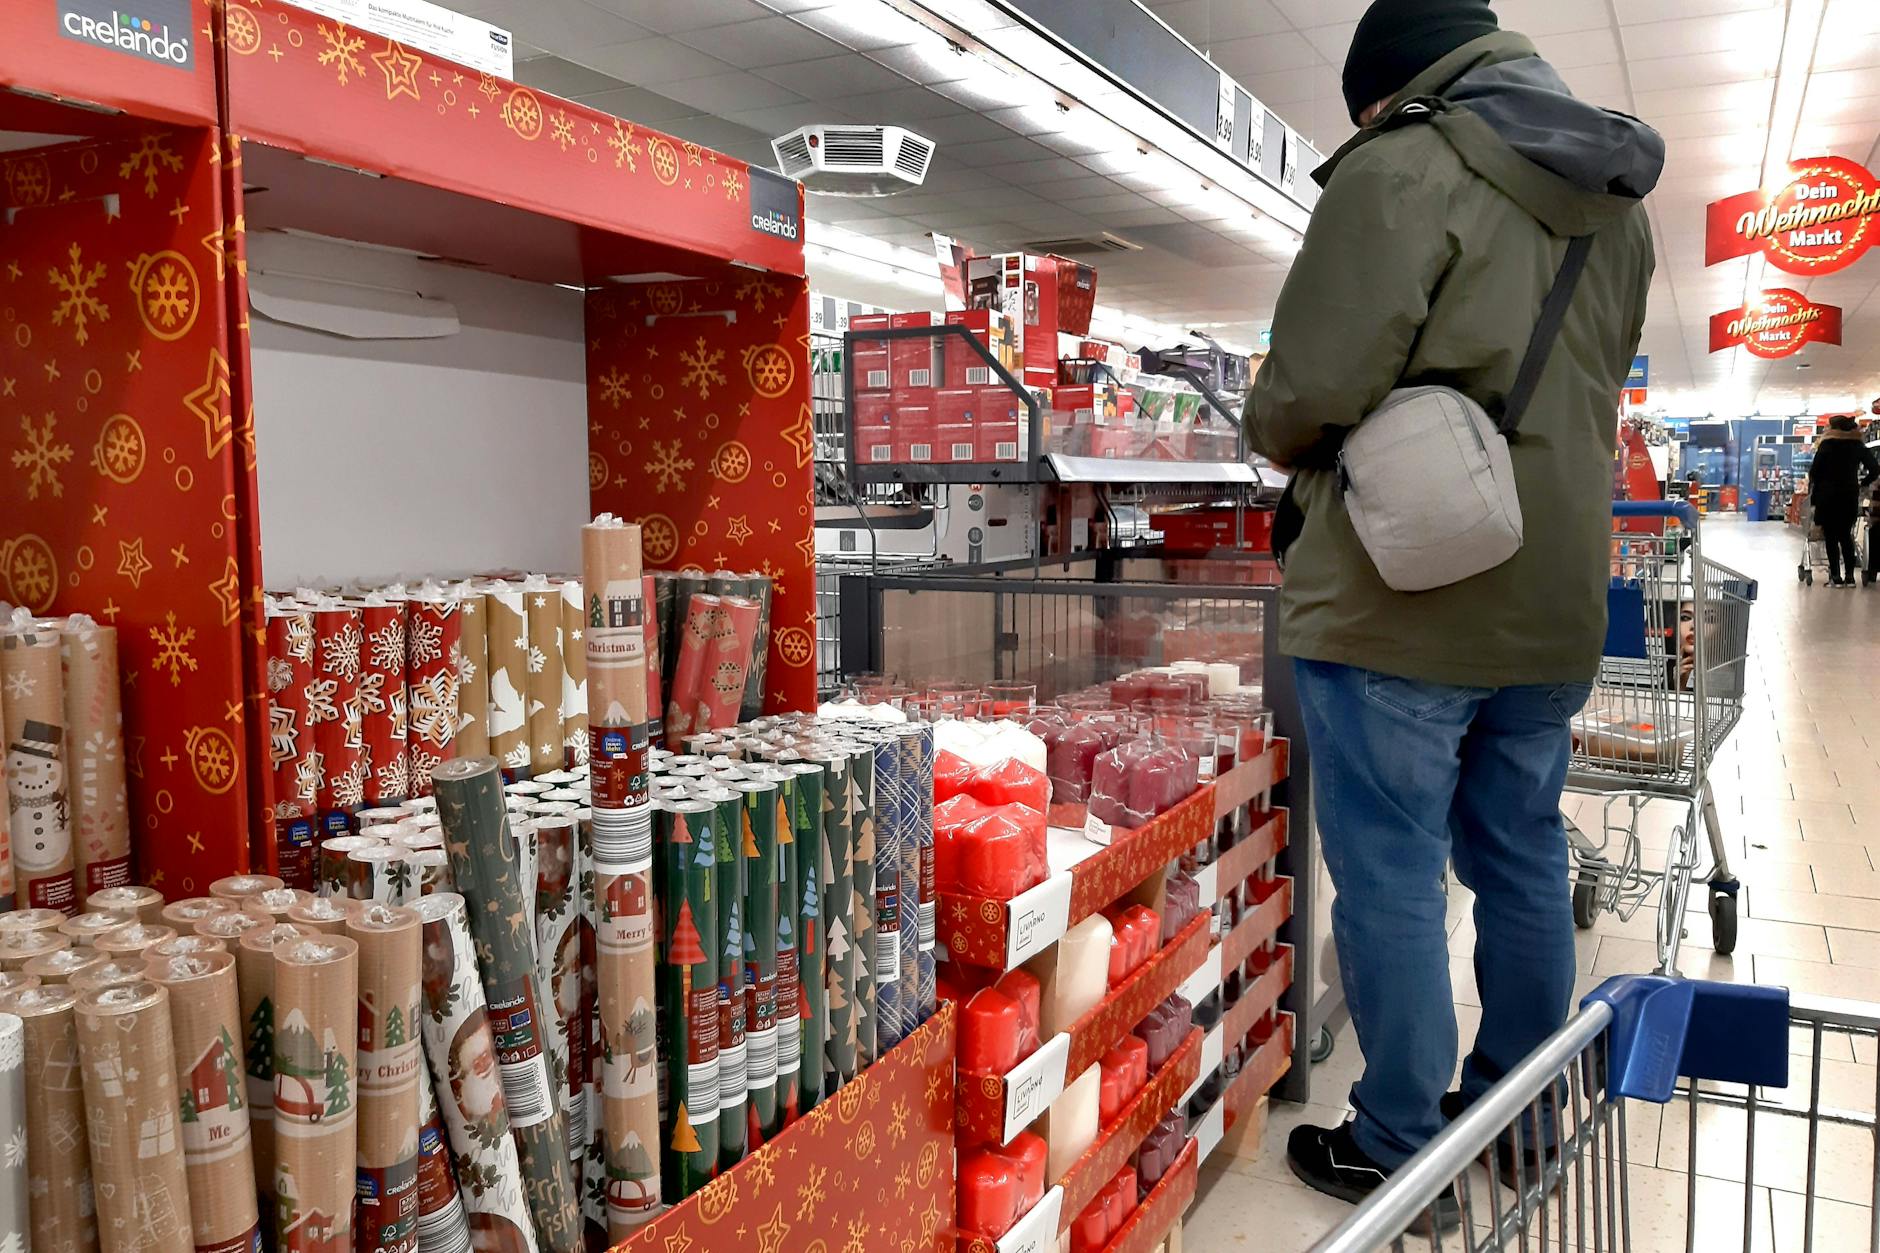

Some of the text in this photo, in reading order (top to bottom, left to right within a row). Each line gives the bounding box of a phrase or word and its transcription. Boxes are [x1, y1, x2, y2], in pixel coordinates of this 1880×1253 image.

[1795, 182, 1838, 200] Dein
[1789, 229, 1843, 247] Markt
[1762, 303, 1788, 314] Dein
[1759, 330, 1791, 342] Markt
[588, 640, 636, 653] Christmas
[616, 928, 646, 940] Merry
